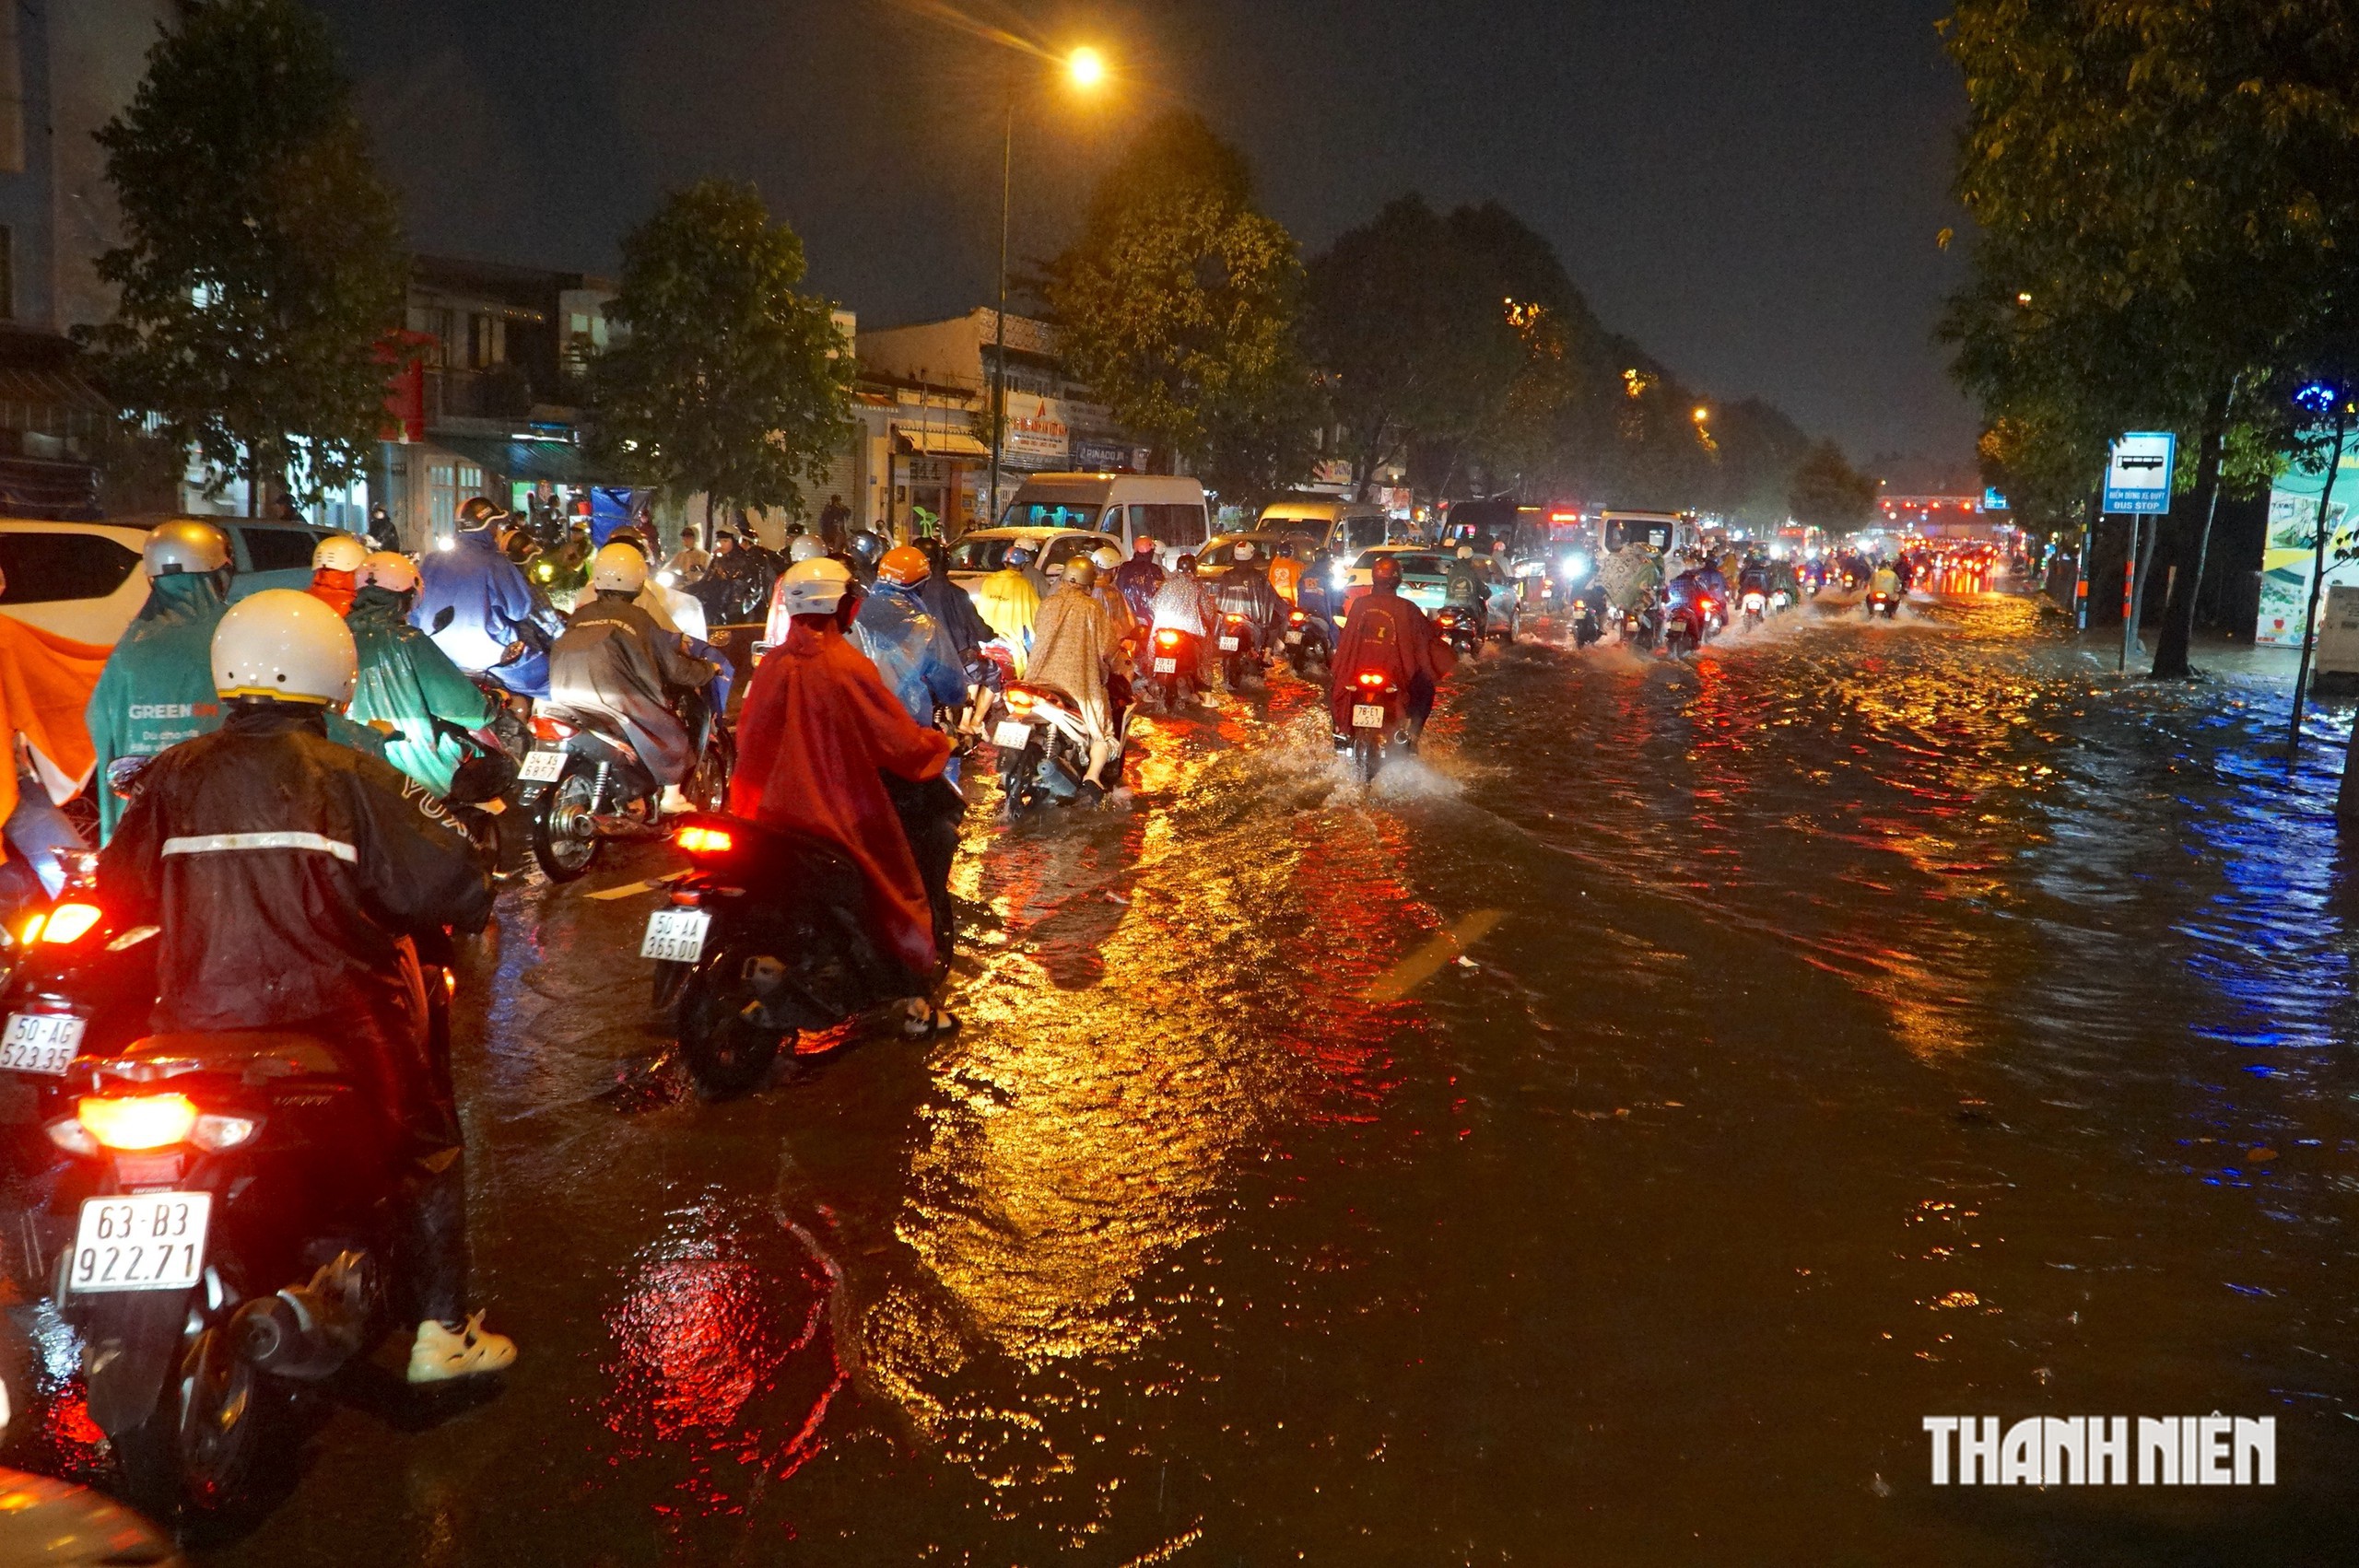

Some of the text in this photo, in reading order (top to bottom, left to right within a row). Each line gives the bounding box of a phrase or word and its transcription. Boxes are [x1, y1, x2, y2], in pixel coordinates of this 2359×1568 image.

[2114, 501, 2160, 509] BUS STOP
[1358, 707, 1379, 717] 78-E1
[655, 915, 699, 938] 50-AA
[646, 936, 698, 959] 365.00
[15, 1017, 74, 1044] 50-AG
[1, 1042, 71, 1071] 523.35
[97, 1202, 190, 1240] 63-B3
[78, 1243, 195, 1282] 922.71
